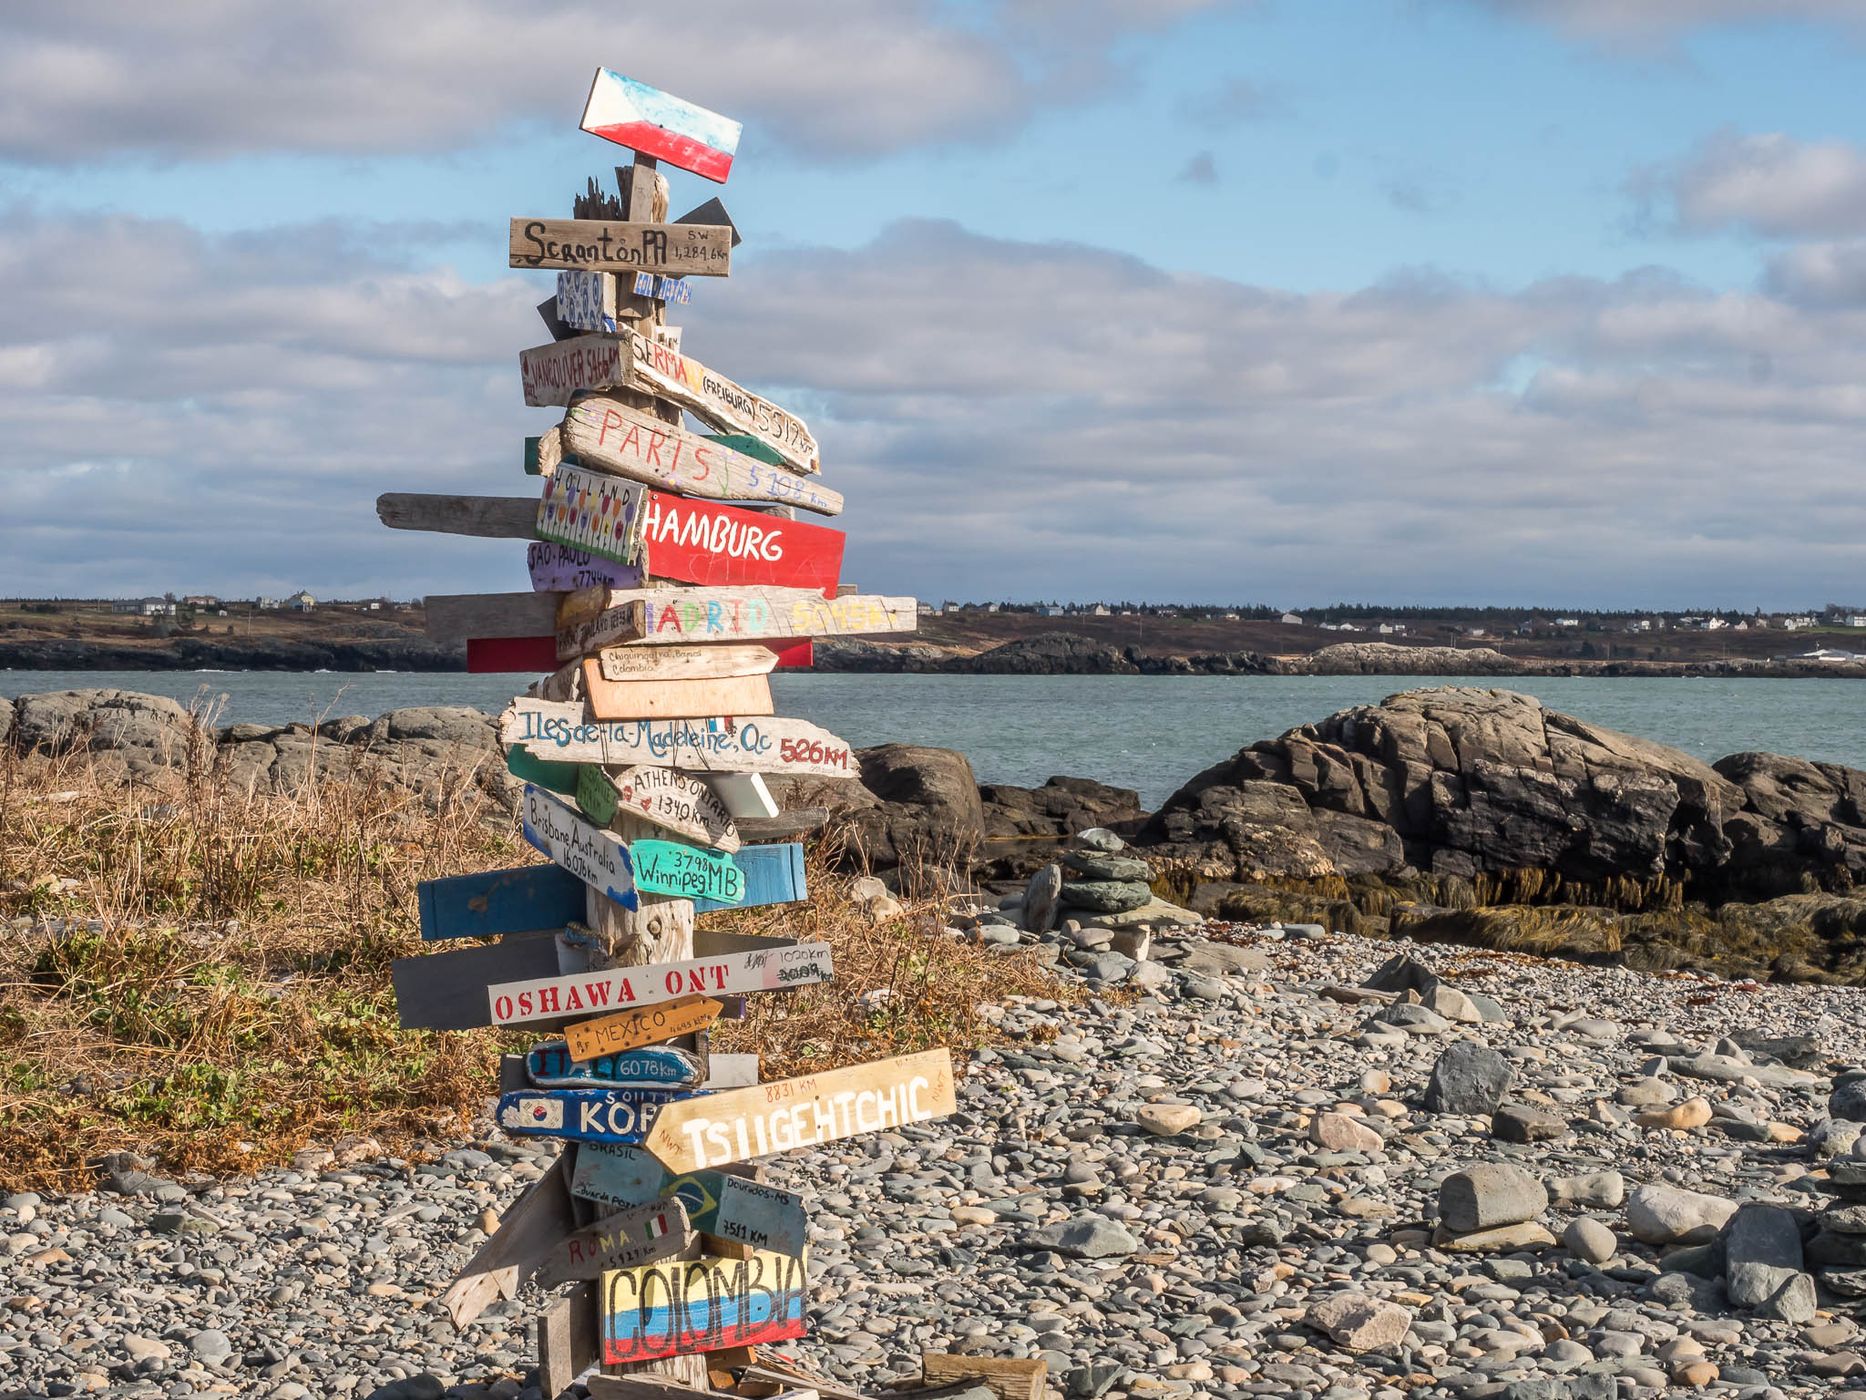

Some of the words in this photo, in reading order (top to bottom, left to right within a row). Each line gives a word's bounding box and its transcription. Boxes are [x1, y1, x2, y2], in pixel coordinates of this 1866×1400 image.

[531, 349, 585, 389] VANCOUVER
[599, 408, 712, 481] PARIS
[555, 469, 631, 506] HOLLAND
[640, 500, 784, 562] HAMBURG
[658, 795, 690, 821] 1340
[689, 780, 735, 837] ONTARIO
[571, 823, 616, 876] Australia
[673, 852, 708, 872] 3798
[495, 977, 636, 1020] OSHAWA
[665, 964, 729, 995] ONT
[595, 1011, 666, 1044] MEXICO
[764, 1085, 795, 1104] 8831
[798, 1079, 818, 1095] KM
[580, 1100, 657, 1135] KOR
[659, 1129, 683, 1155] NWT
[567, 1229, 631, 1265] ROMA
[750, 1229, 768, 1247] KM
[608, 1253, 808, 1358] COLOMBIA
